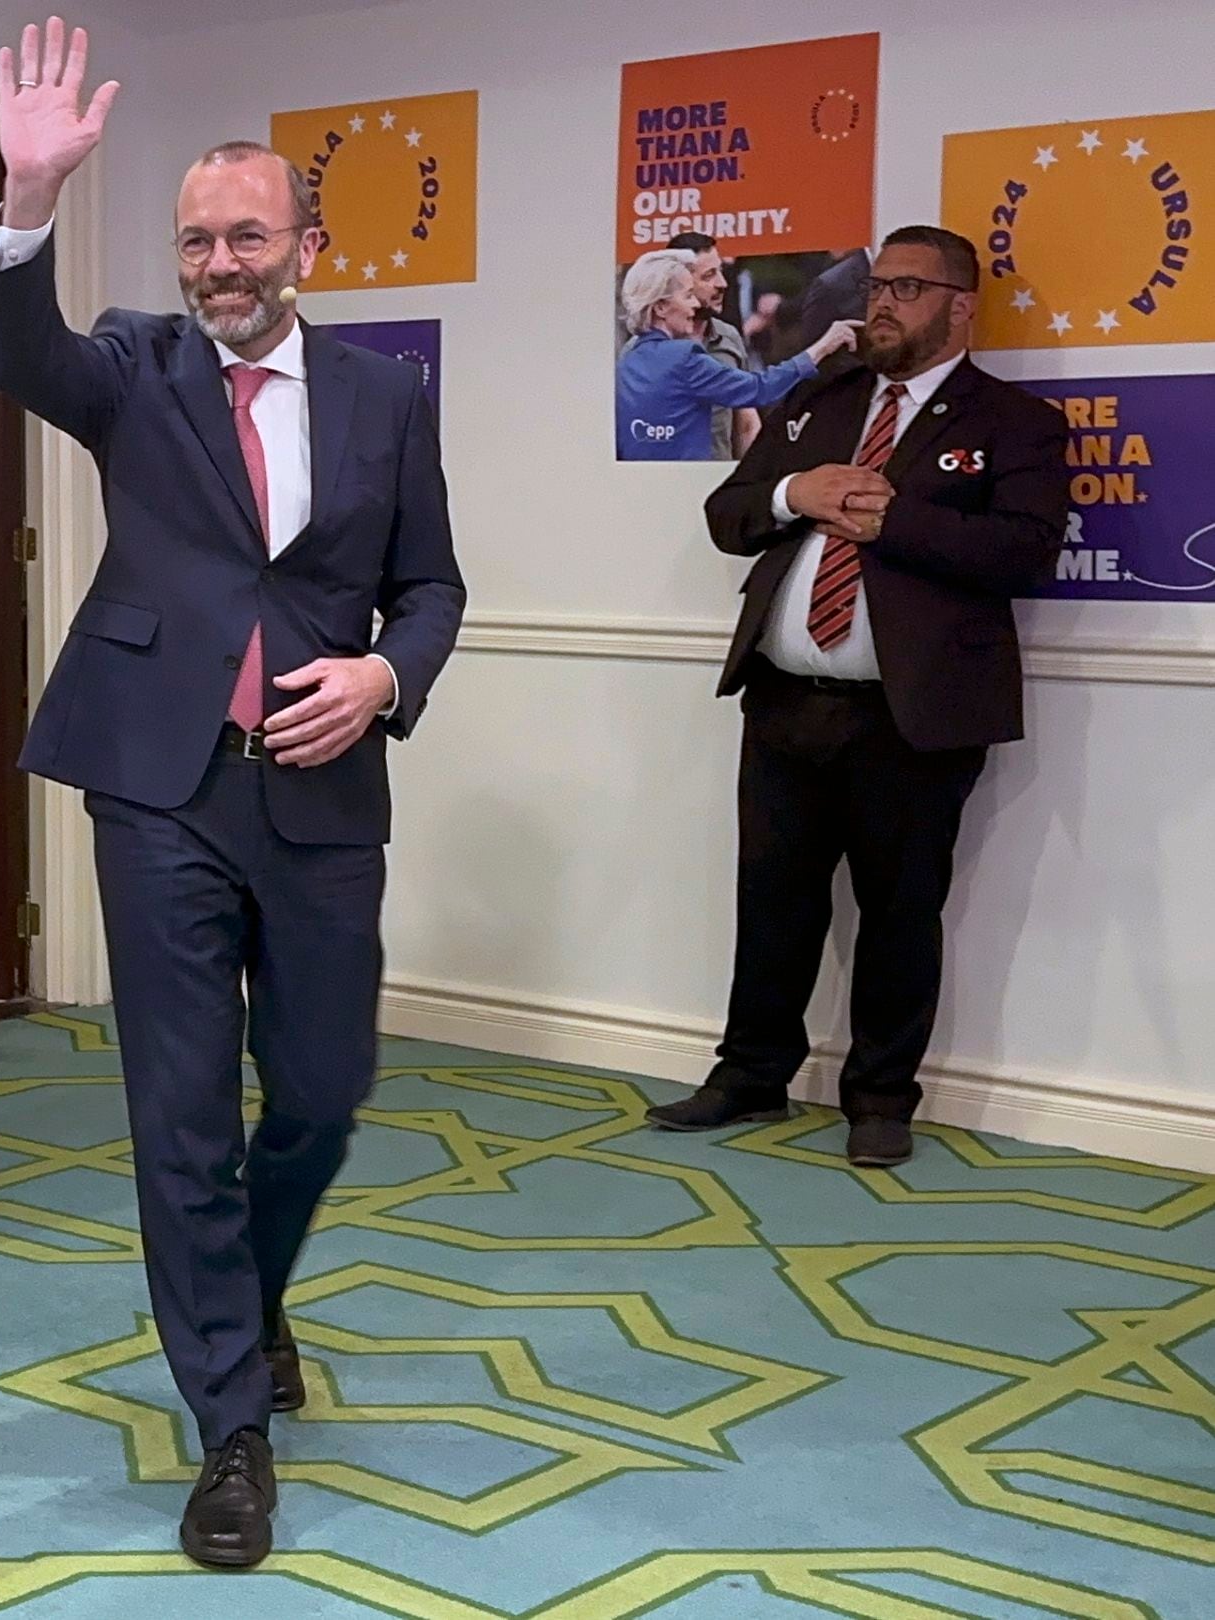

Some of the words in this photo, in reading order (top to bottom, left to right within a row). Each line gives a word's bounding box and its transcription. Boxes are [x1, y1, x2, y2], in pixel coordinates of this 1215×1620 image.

[637, 101, 727, 134] MORE
[636, 130, 722, 161] THAN
[728, 127, 750, 152] A
[411, 156, 439, 241] 2024
[633, 187, 701, 216] OUR
[633, 208, 792, 244] SECURITY.
[989, 179, 1028, 279] 2024
[1126, 161, 1192, 316] URSULA
[1052, 396, 1118, 428] RE
[646, 425, 675, 440] epp
[938, 449, 985, 474] G4S
[1118, 434, 1152, 466] A
[1070, 473, 1148, 505] ON.
[1056, 550, 1132, 581] ME.
